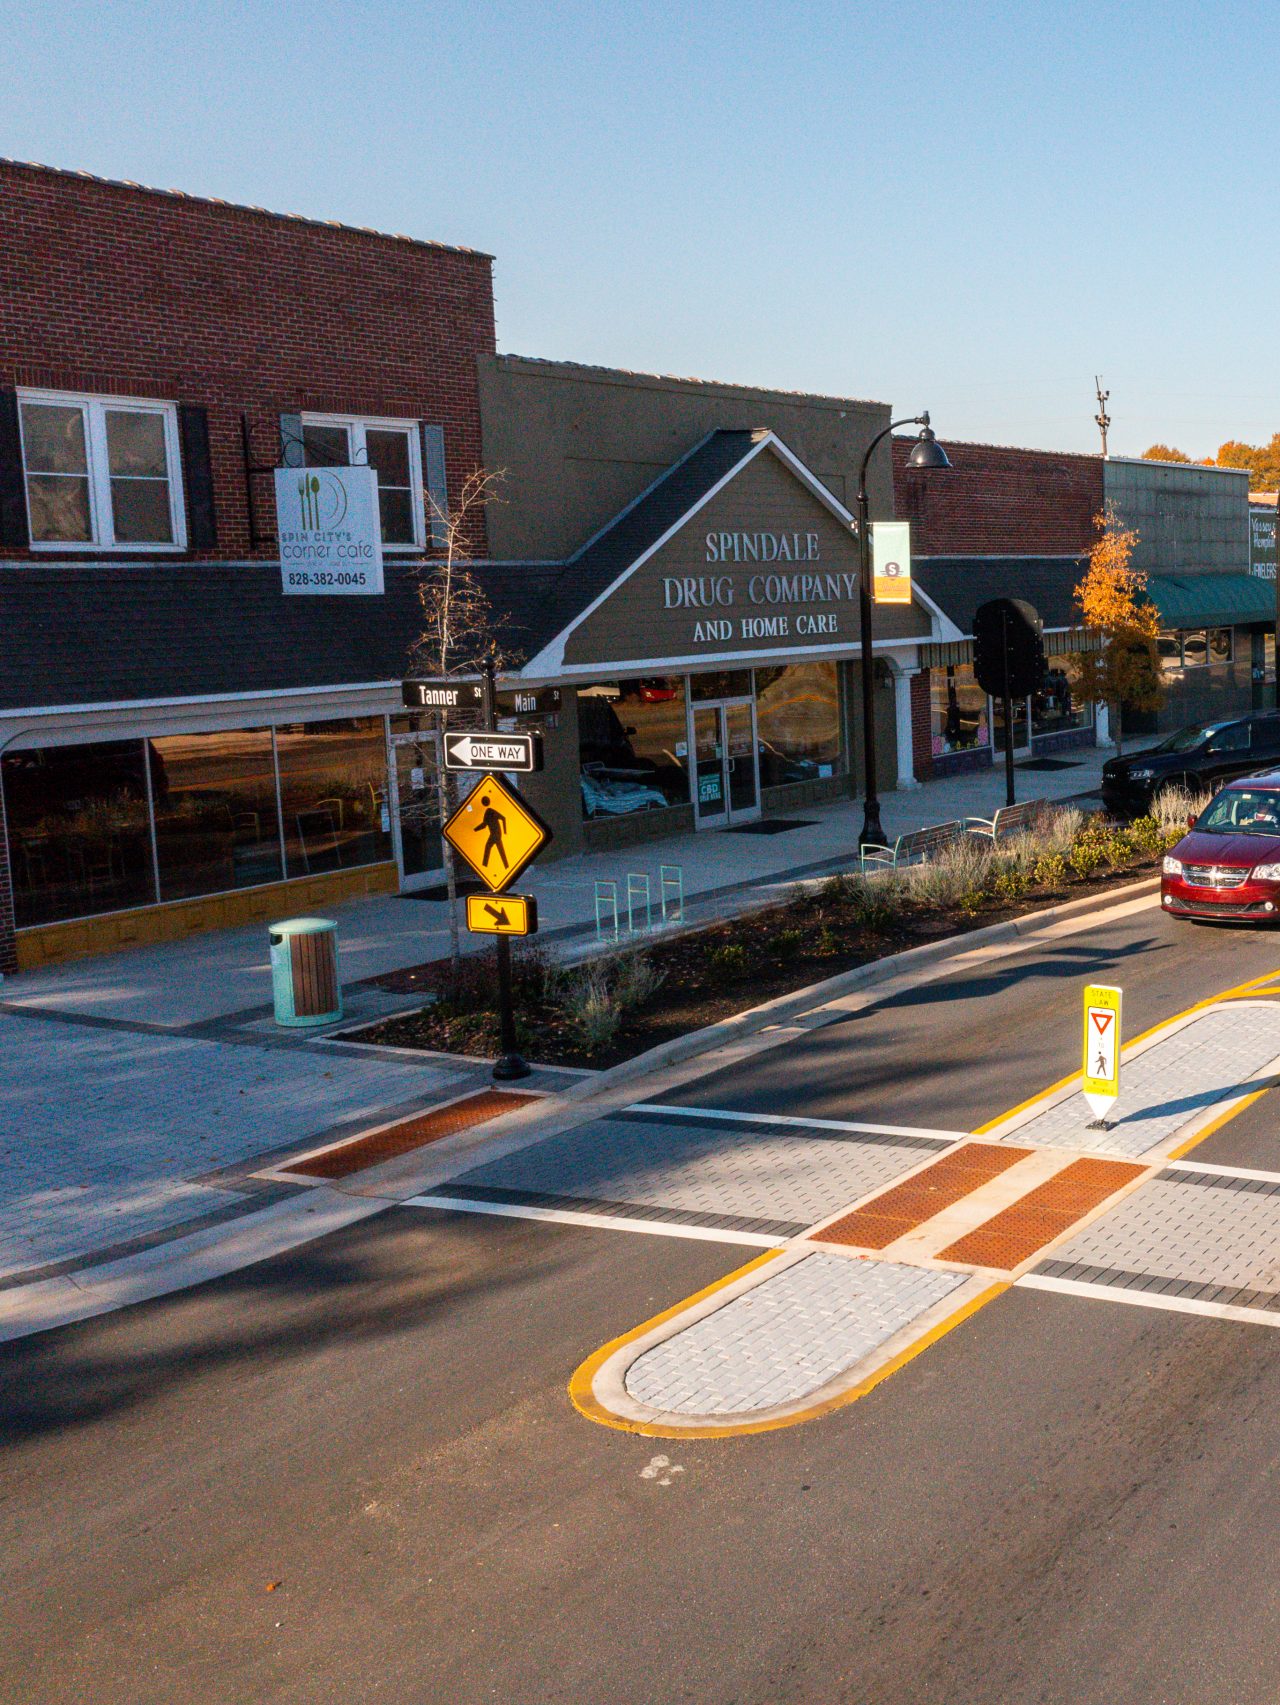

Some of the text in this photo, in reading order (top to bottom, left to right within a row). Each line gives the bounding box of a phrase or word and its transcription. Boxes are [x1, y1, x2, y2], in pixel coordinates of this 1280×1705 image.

[281, 531, 352, 542] SPIN CITY'S
[282, 540, 373, 558] corner cafe
[705, 532, 820, 563] SPINDALE
[289, 572, 366, 585] 828-382-0045
[888, 564, 897, 575] S
[663, 573, 857, 608] DRUG COMPANY
[693, 614, 838, 642] AND HOME CARE
[419, 685, 482, 706] Tanner St
[515, 694, 537, 712] Main
[471, 745, 522, 760] ONE WAY
[701, 783, 718, 795] CBD
